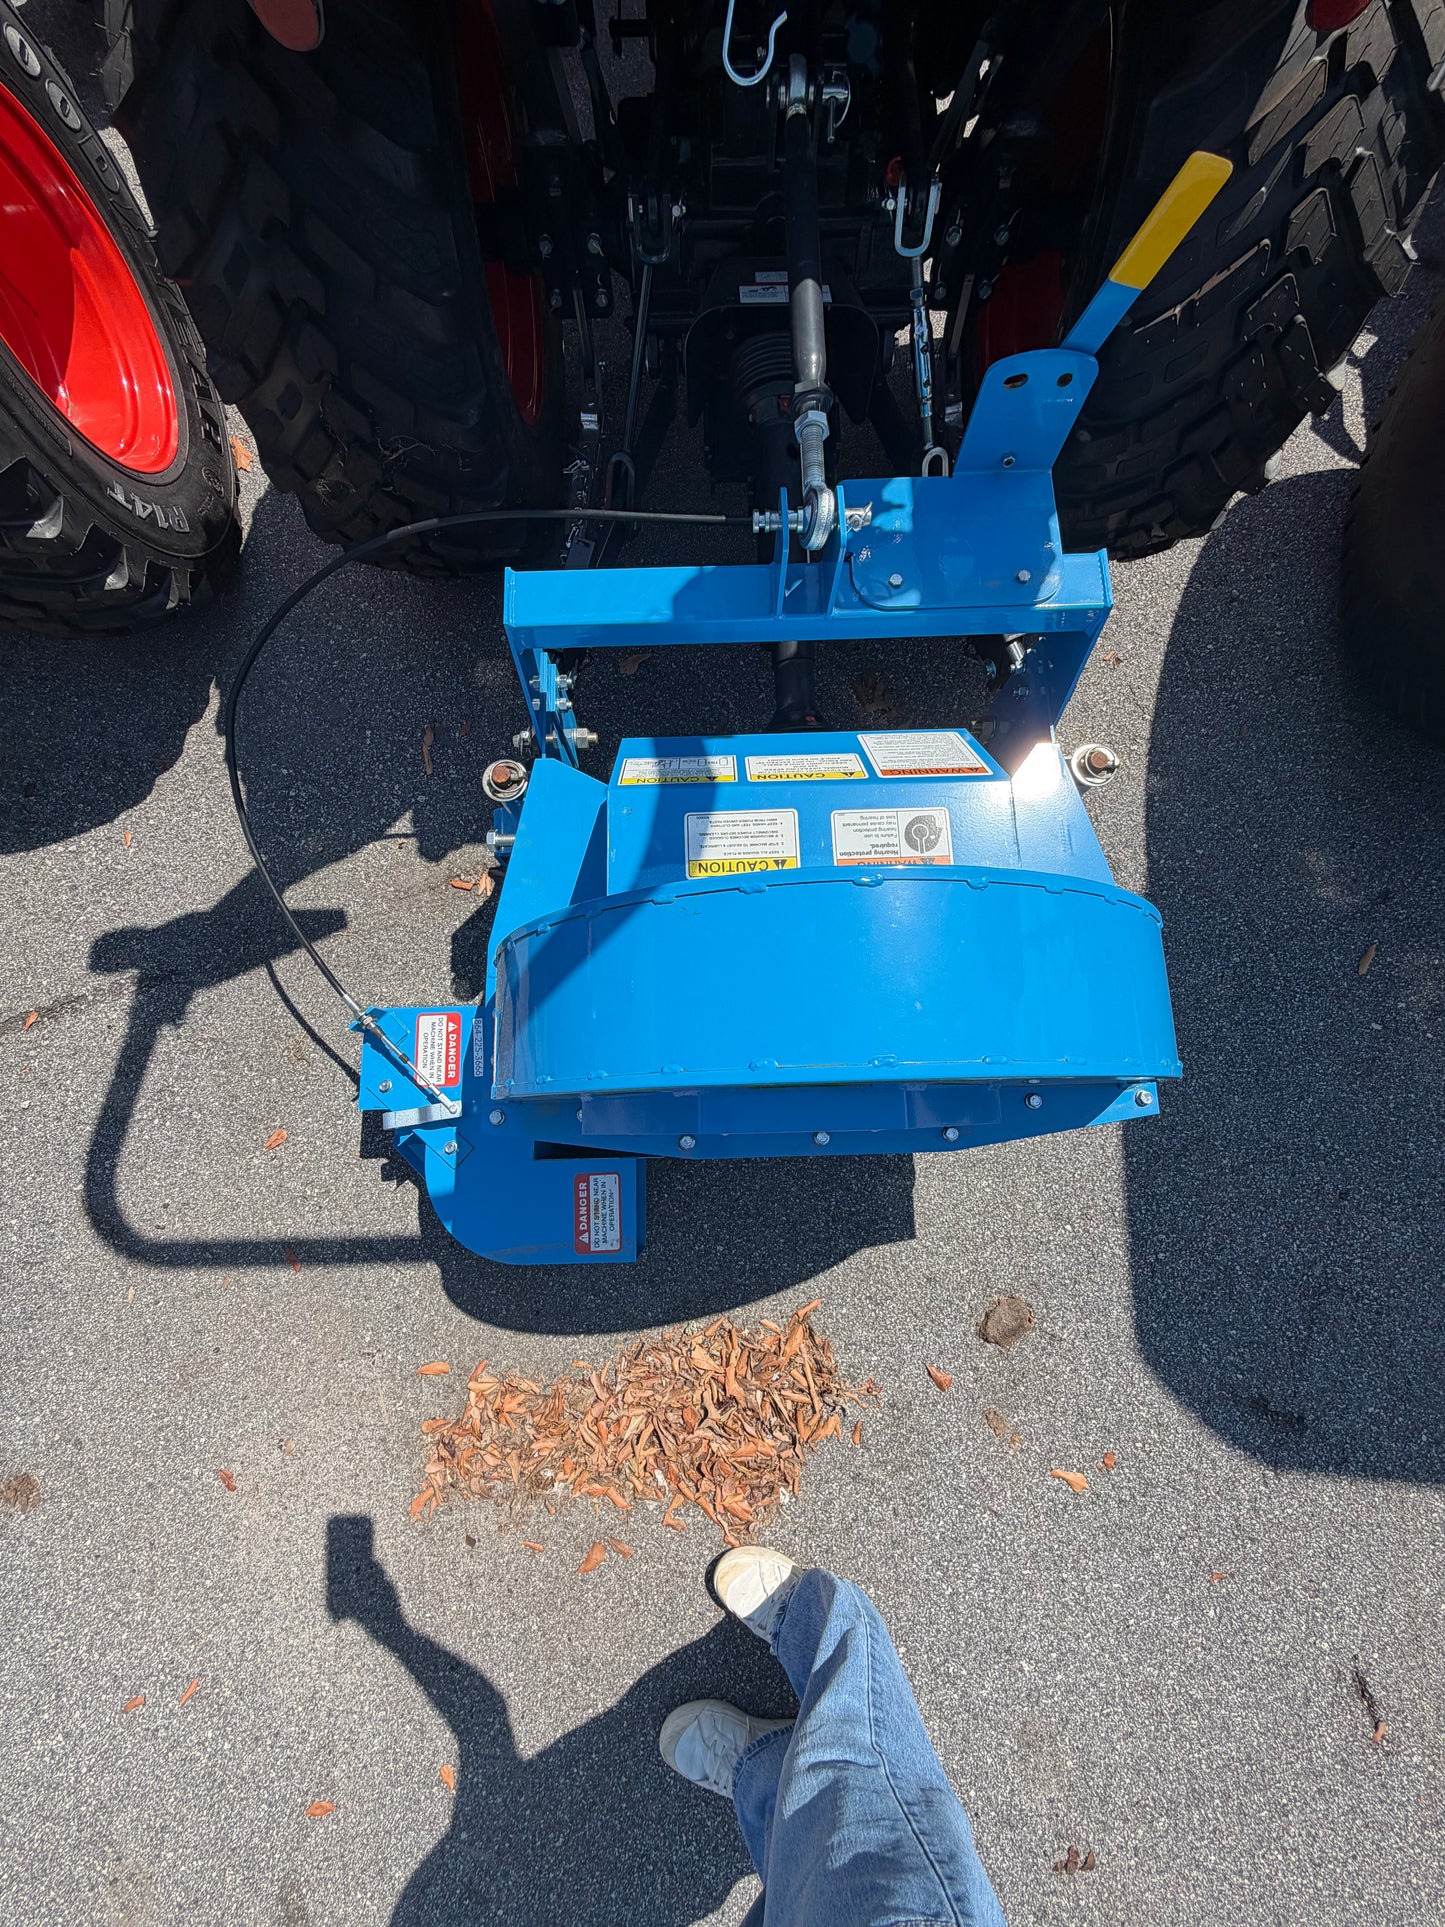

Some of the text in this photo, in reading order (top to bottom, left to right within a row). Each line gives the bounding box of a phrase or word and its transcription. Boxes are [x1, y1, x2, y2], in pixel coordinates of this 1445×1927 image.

[107, 479, 190, 534] R14T
[698, 860, 769, 873] CAUTION
[438, 1018, 444, 1027] DO
[448, 1034, 456, 1078] DANGER
[474, 1019, 482, 1076] 864-225-3666
[579, 1182, 587, 1230] DANGER
[594, 1238, 600, 1248] DO
